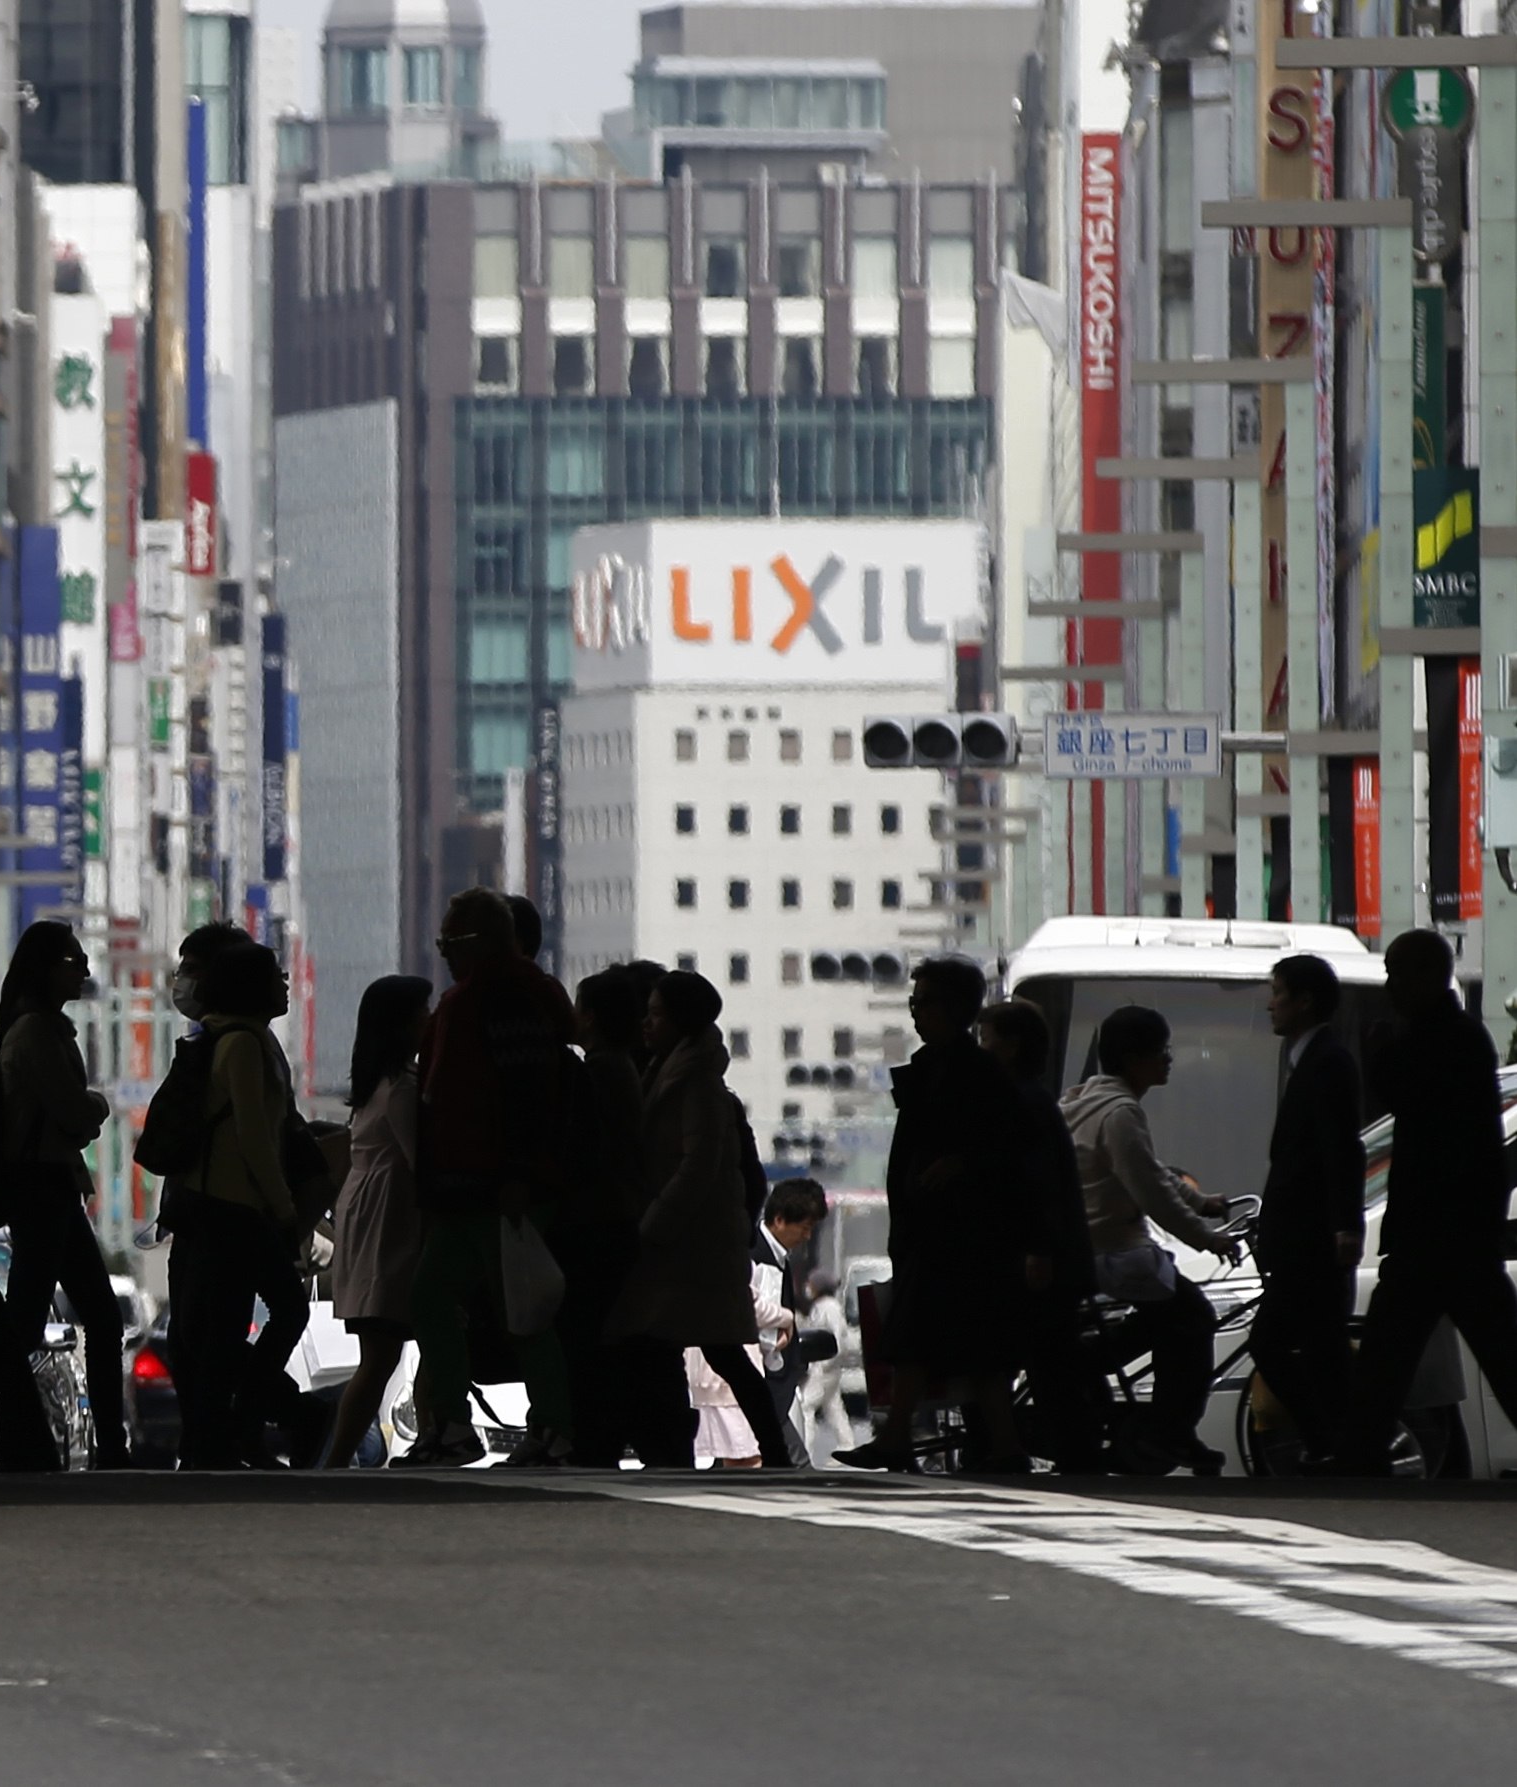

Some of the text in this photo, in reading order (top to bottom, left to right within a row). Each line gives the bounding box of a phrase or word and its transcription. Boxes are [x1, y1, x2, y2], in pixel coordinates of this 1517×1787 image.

[1087, 146, 1115, 391] MITSUKOSHI
[670, 552, 946, 656] LIXIL
[1412, 572, 1476, 595] SMBC
[1057, 727, 1208, 755] 銀座七丁目
